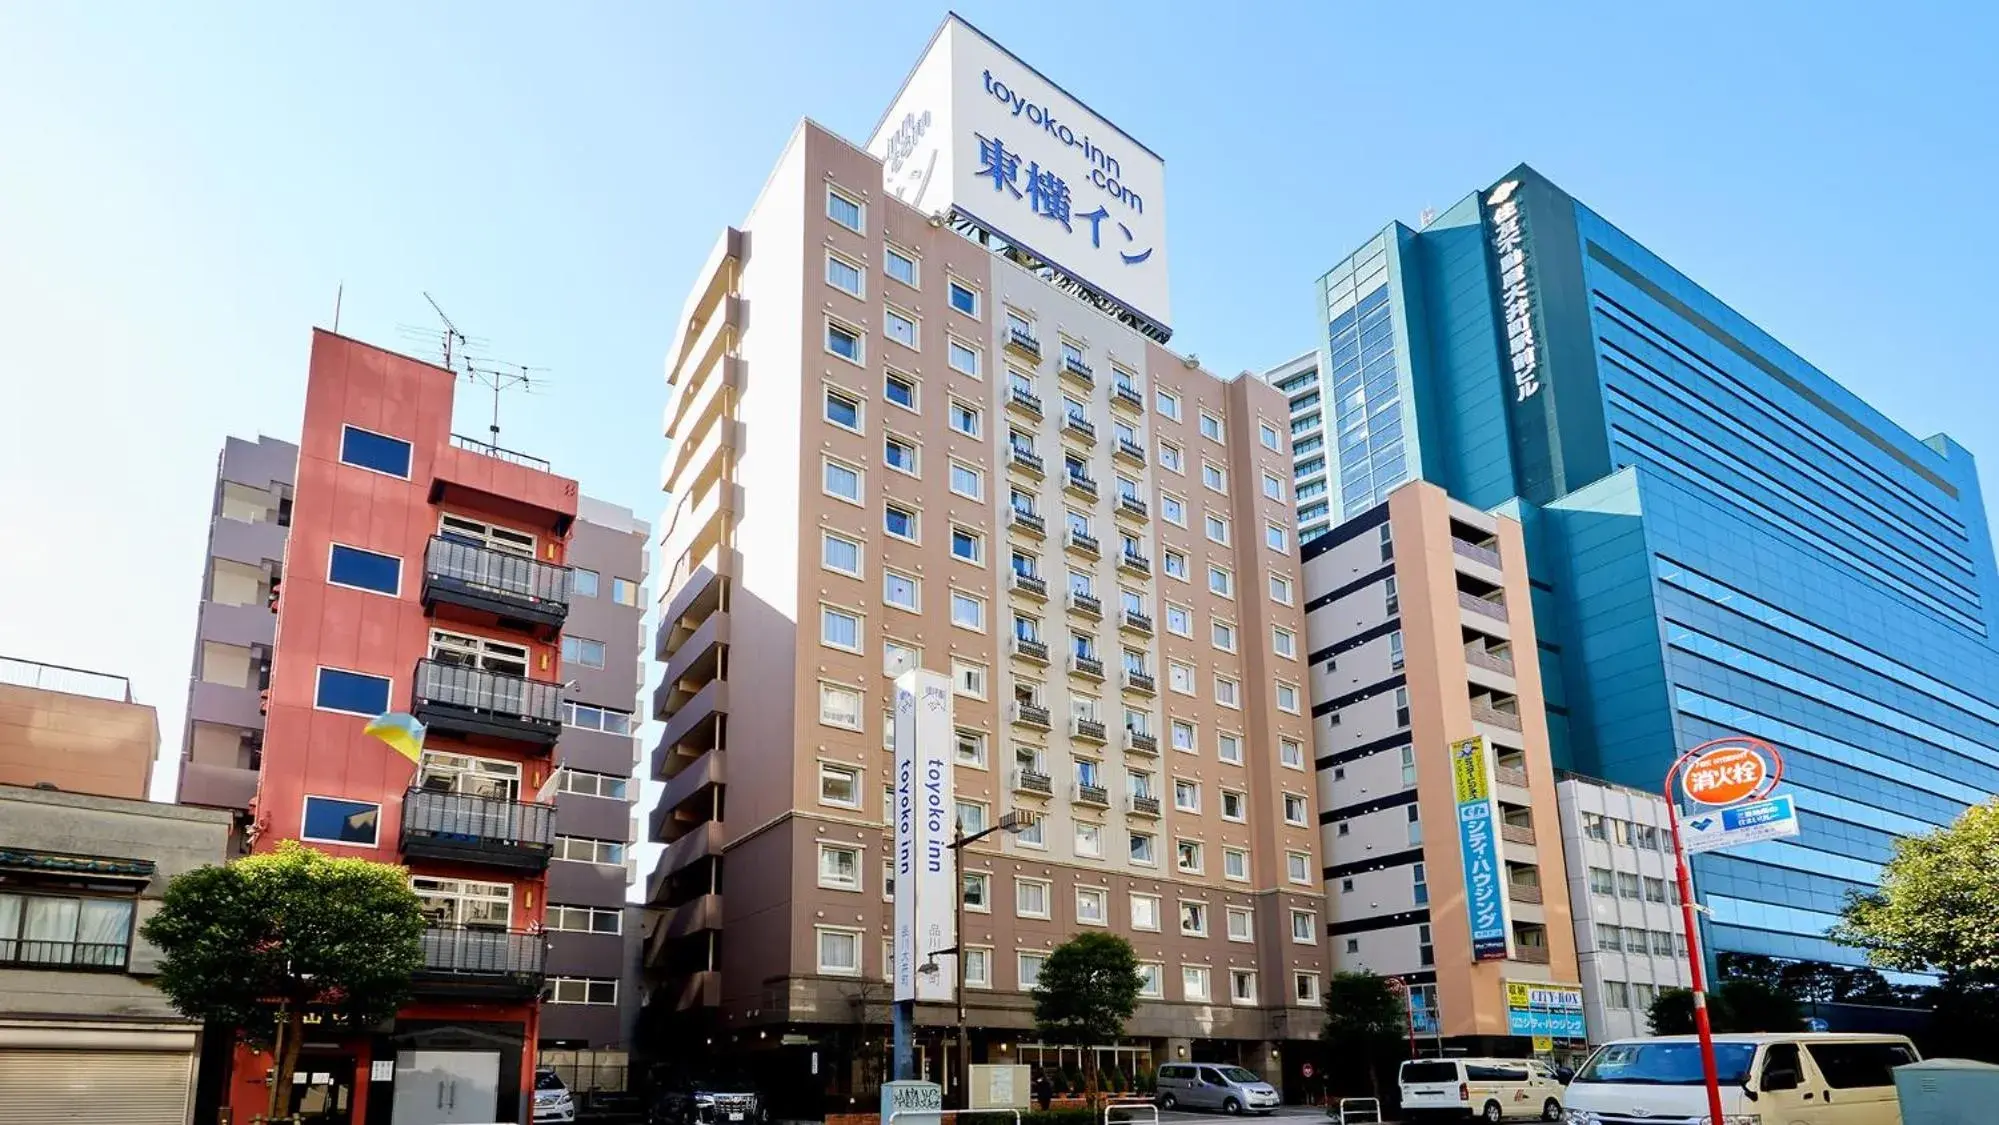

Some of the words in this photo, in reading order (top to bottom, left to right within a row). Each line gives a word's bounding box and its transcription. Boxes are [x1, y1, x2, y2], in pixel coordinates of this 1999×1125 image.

[983, 69, 1120, 178] toyoko-inn
[975, 131, 1152, 264] 東横イン
[1495, 201, 1539, 402] 住友不動産大井町駅前ビル
[899, 759, 912, 834] toyoko
[925, 759, 945, 833] toyoko
[1691, 760, 1758, 793] 消火栓
[901, 840, 911, 874] inn
[928, 839, 945, 873] inn
[1467, 820, 1497, 929] シティ・ハウジング
[928, 923, 941, 987] 品川町
